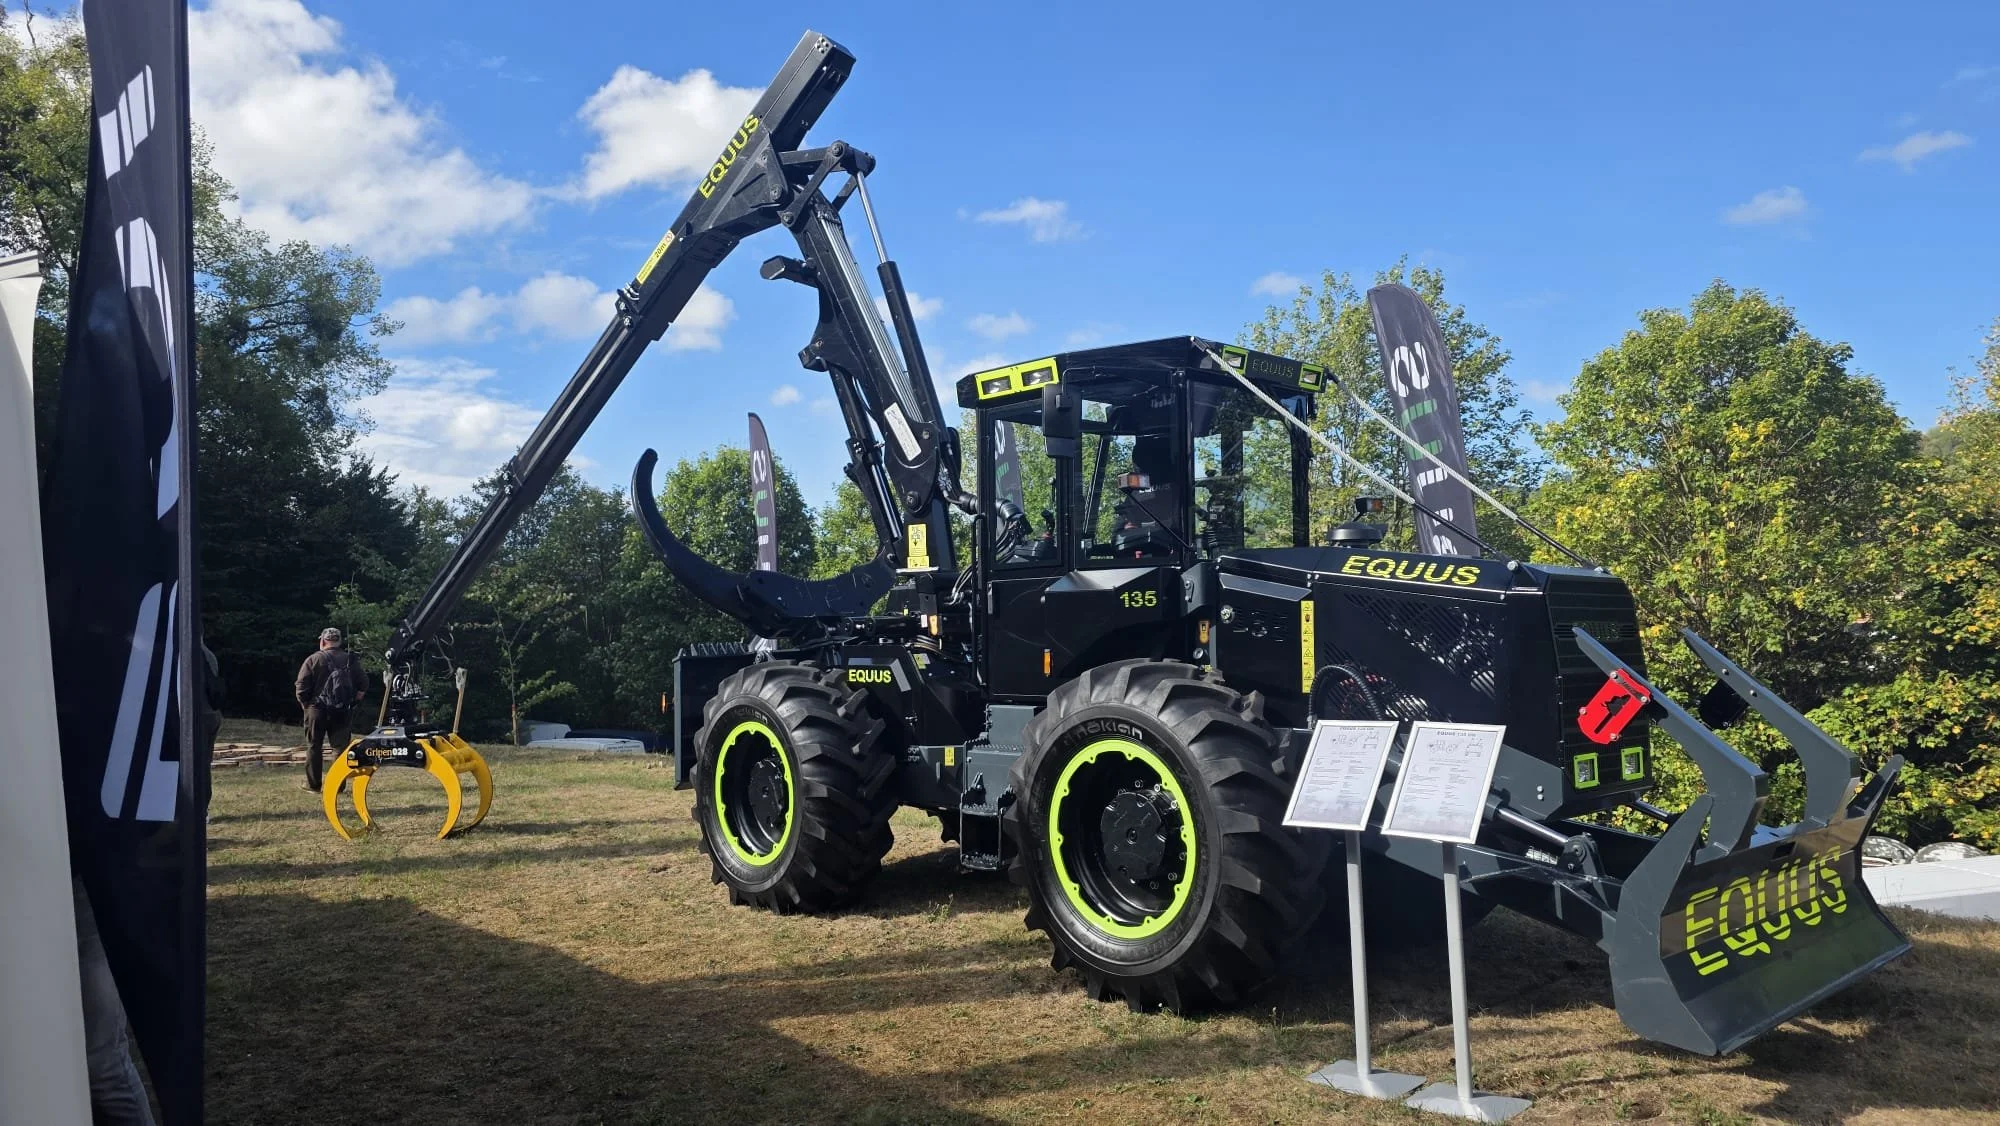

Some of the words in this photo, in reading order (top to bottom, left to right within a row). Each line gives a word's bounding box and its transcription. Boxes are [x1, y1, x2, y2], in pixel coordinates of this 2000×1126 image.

[699, 114, 759, 199] EQUUS
[1252, 358, 1294, 377] EQUUS
[1341, 555, 1481, 585] EQUUS
[1119, 590, 1157, 608] 135
[848, 669, 892, 683] EQUUS
[1686, 845, 1847, 976] EQUUS
